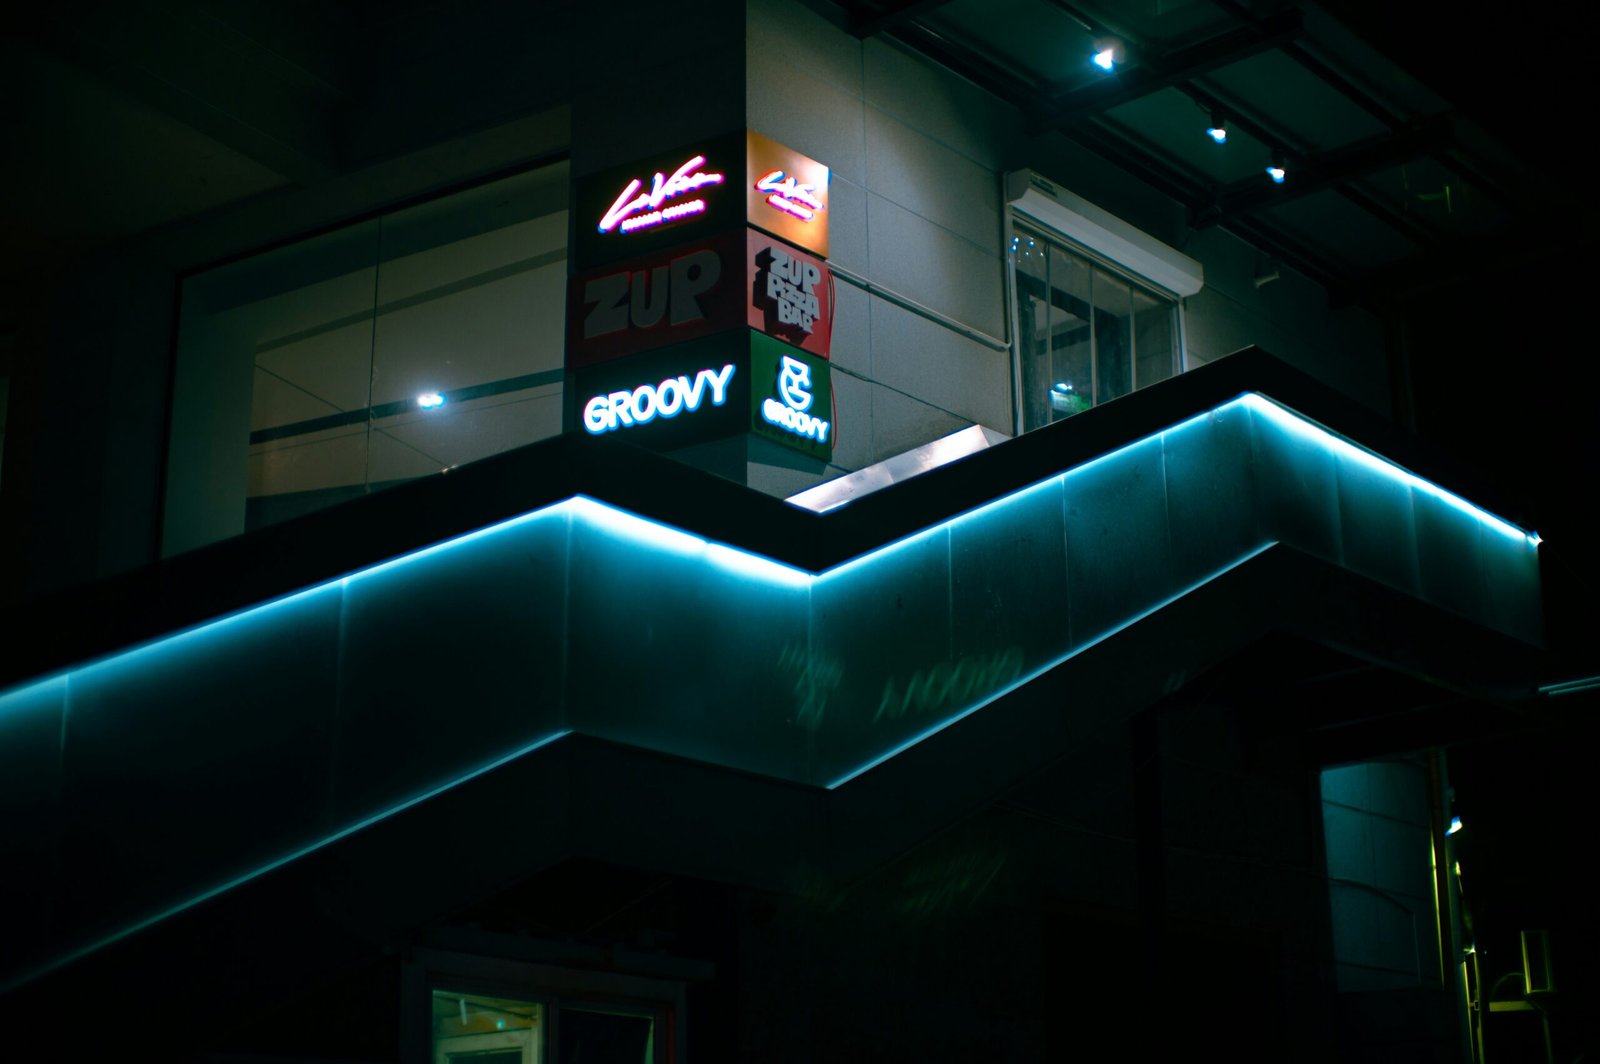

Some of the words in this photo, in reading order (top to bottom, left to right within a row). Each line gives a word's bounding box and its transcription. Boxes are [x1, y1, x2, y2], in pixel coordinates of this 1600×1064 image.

[584, 249, 722, 340] ZUP
[767, 271, 820, 320] PIZZA
[770, 246, 821, 296] ZUP
[778, 296, 813, 335] BAR
[583, 364, 735, 433] GROOVY
